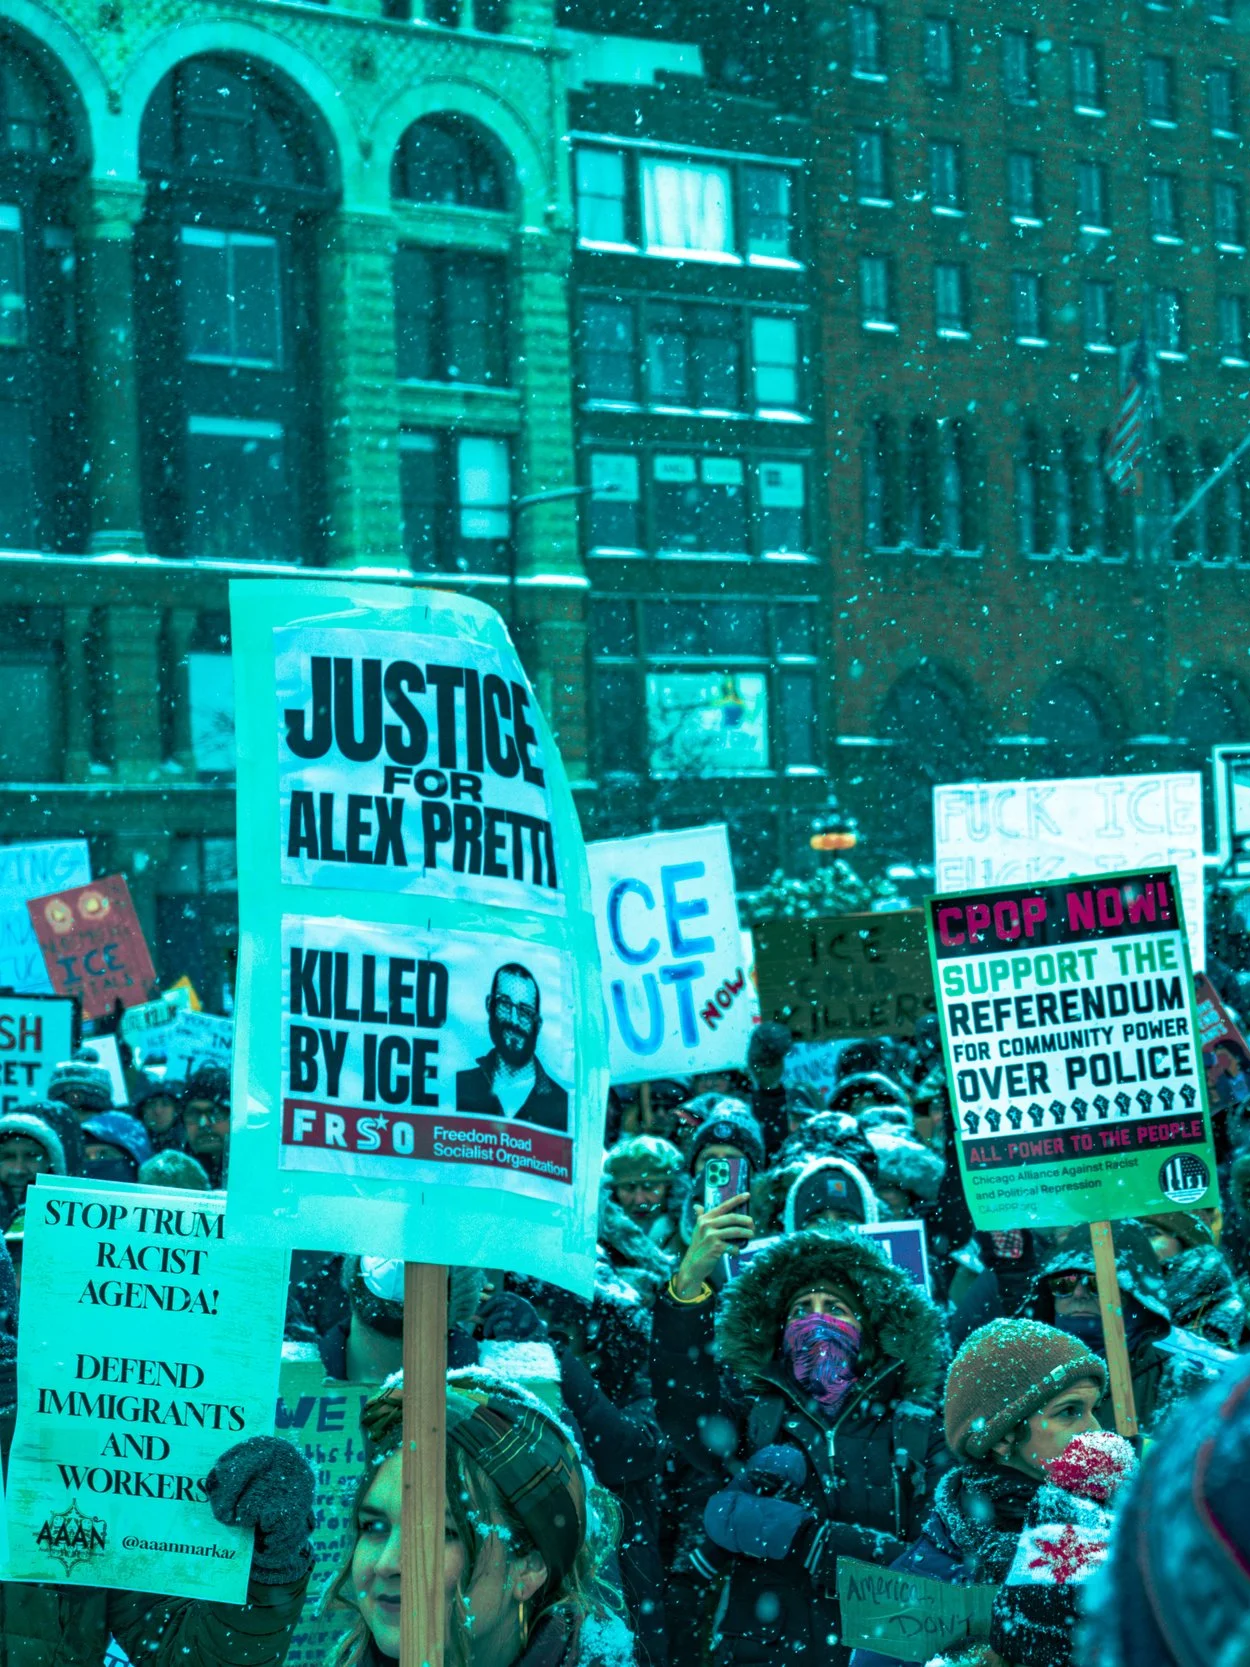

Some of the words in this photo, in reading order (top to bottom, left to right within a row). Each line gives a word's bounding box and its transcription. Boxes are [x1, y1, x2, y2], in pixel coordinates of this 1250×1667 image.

[284, 655, 545, 787] JUSTICE
[383, 765, 484, 802] FOR
[937, 786, 1063, 844] FUCK
[1095, 777, 1197, 839] ICE
[287, 791, 408, 868] ALEX
[422, 797, 558, 890] PRETTI
[937, 897, 1048, 947] CPOP
[1066, 881, 1172, 931] NOW!
[56, 943, 125, 985] ICE
[810, 925, 890, 967] ICE
[942, 949, 1104, 997] SUPPORT
[1114, 936, 1179, 975] THE
[289, 946, 450, 1030] KILLED
[700, 966, 746, 1031] NOW
[948, 976, 1185, 1036] REFERENDUM
[953, 1039, 990, 1064] FOR
[997, 1026, 1114, 1060] COMMUNITY
[1123, 1016, 1190, 1043] POWER
[289, 1023, 350, 1096] BY
[363, 1030, 440, 1107] ICE
[956, 1057, 1049, 1104] OVER
[1065, 1042, 1194, 1092] POLICE
[292, 1108, 415, 1155] FRSO
[433, 1125, 497, 1146] Freedom
[500, 1132, 533, 1152] Road
[969, 1147, 1002, 1164] ALL
[1008, 1138, 1065, 1160] POWER
[1070, 1133, 1094, 1151] TO
[1101, 1128, 1131, 1148] THE
[1137, 1120, 1202, 1144] PEOPLE
[433, 1143, 494, 1162] Socialist
[496, 1149, 569, 1178] Organization
[972, 1169, 1016, 1187] Chicago
[1018, 1165, 1060, 1181] Alliance
[1062, 1162, 1103, 1179] Against
[1106, 1157, 1139, 1171] Racist
[975, 1189, 995, 1201] and
[997, 1184, 1039, 1199] Political
[1041, 1178, 1102, 1196] Repression
[45, 1199, 128, 1230] STOP
[96, 1241, 208, 1276] RACIST
[78, 1279, 220, 1315] AGENDA!
[75, 1353, 205, 1389] DEFEND
[36, 1388, 246, 1432] IMMIGRANTS
[275, 1395, 347, 1433] WE
[101, 1433, 170, 1462] AND
[57, 1463, 210, 1503] WORKERS
[36, 1520, 105, 1551] AAAN
[122, 1535, 236, 1561] @aaanmarkaz
